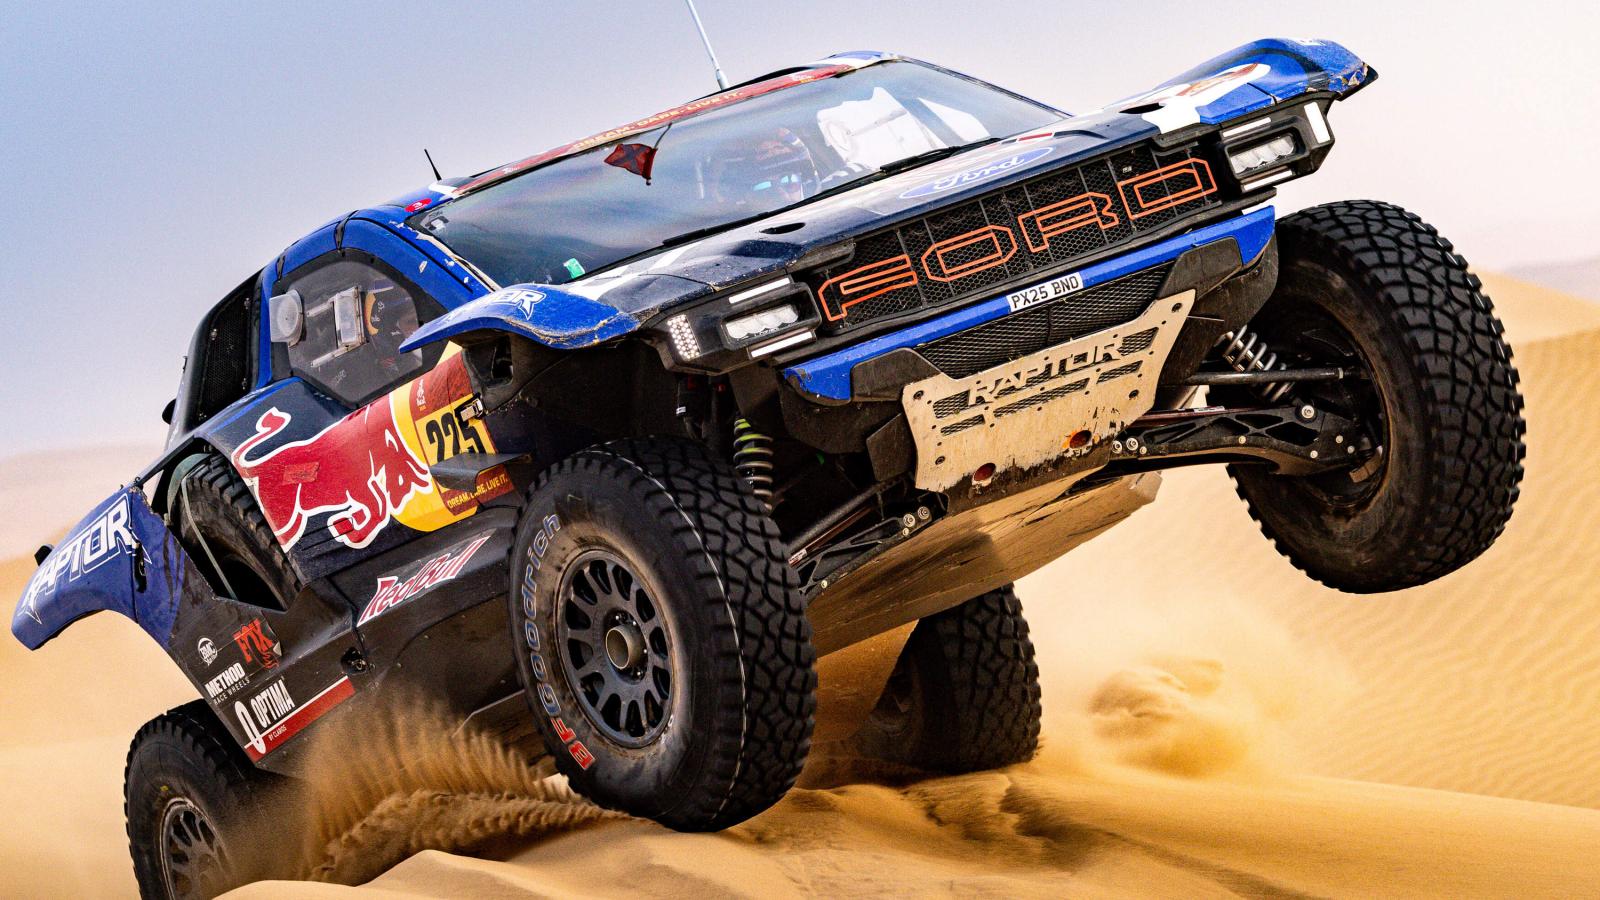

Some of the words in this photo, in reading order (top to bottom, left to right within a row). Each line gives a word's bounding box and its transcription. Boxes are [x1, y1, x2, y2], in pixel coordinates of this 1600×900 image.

[933, 156, 1025, 190] Ford
[818, 157, 1218, 322] FORD
[1011, 286, 1049, 309] PX25
[968, 337, 1124, 407] RAPTOR
[426, 411, 487, 462] 225
[447, 491, 470, 508] DREAM.
[487, 476, 499, 490] LIVE
[18, 494, 146, 622] RAPTOR
[233, 618, 273, 665] FOX
[522, 513, 596, 771] BFGoodrich
[204, 662, 246, 698] METHOD
[213, 693, 228, 706] RACE
[226, 675, 251, 697] WHEELS
[250, 679, 296, 728] OPTIMA
